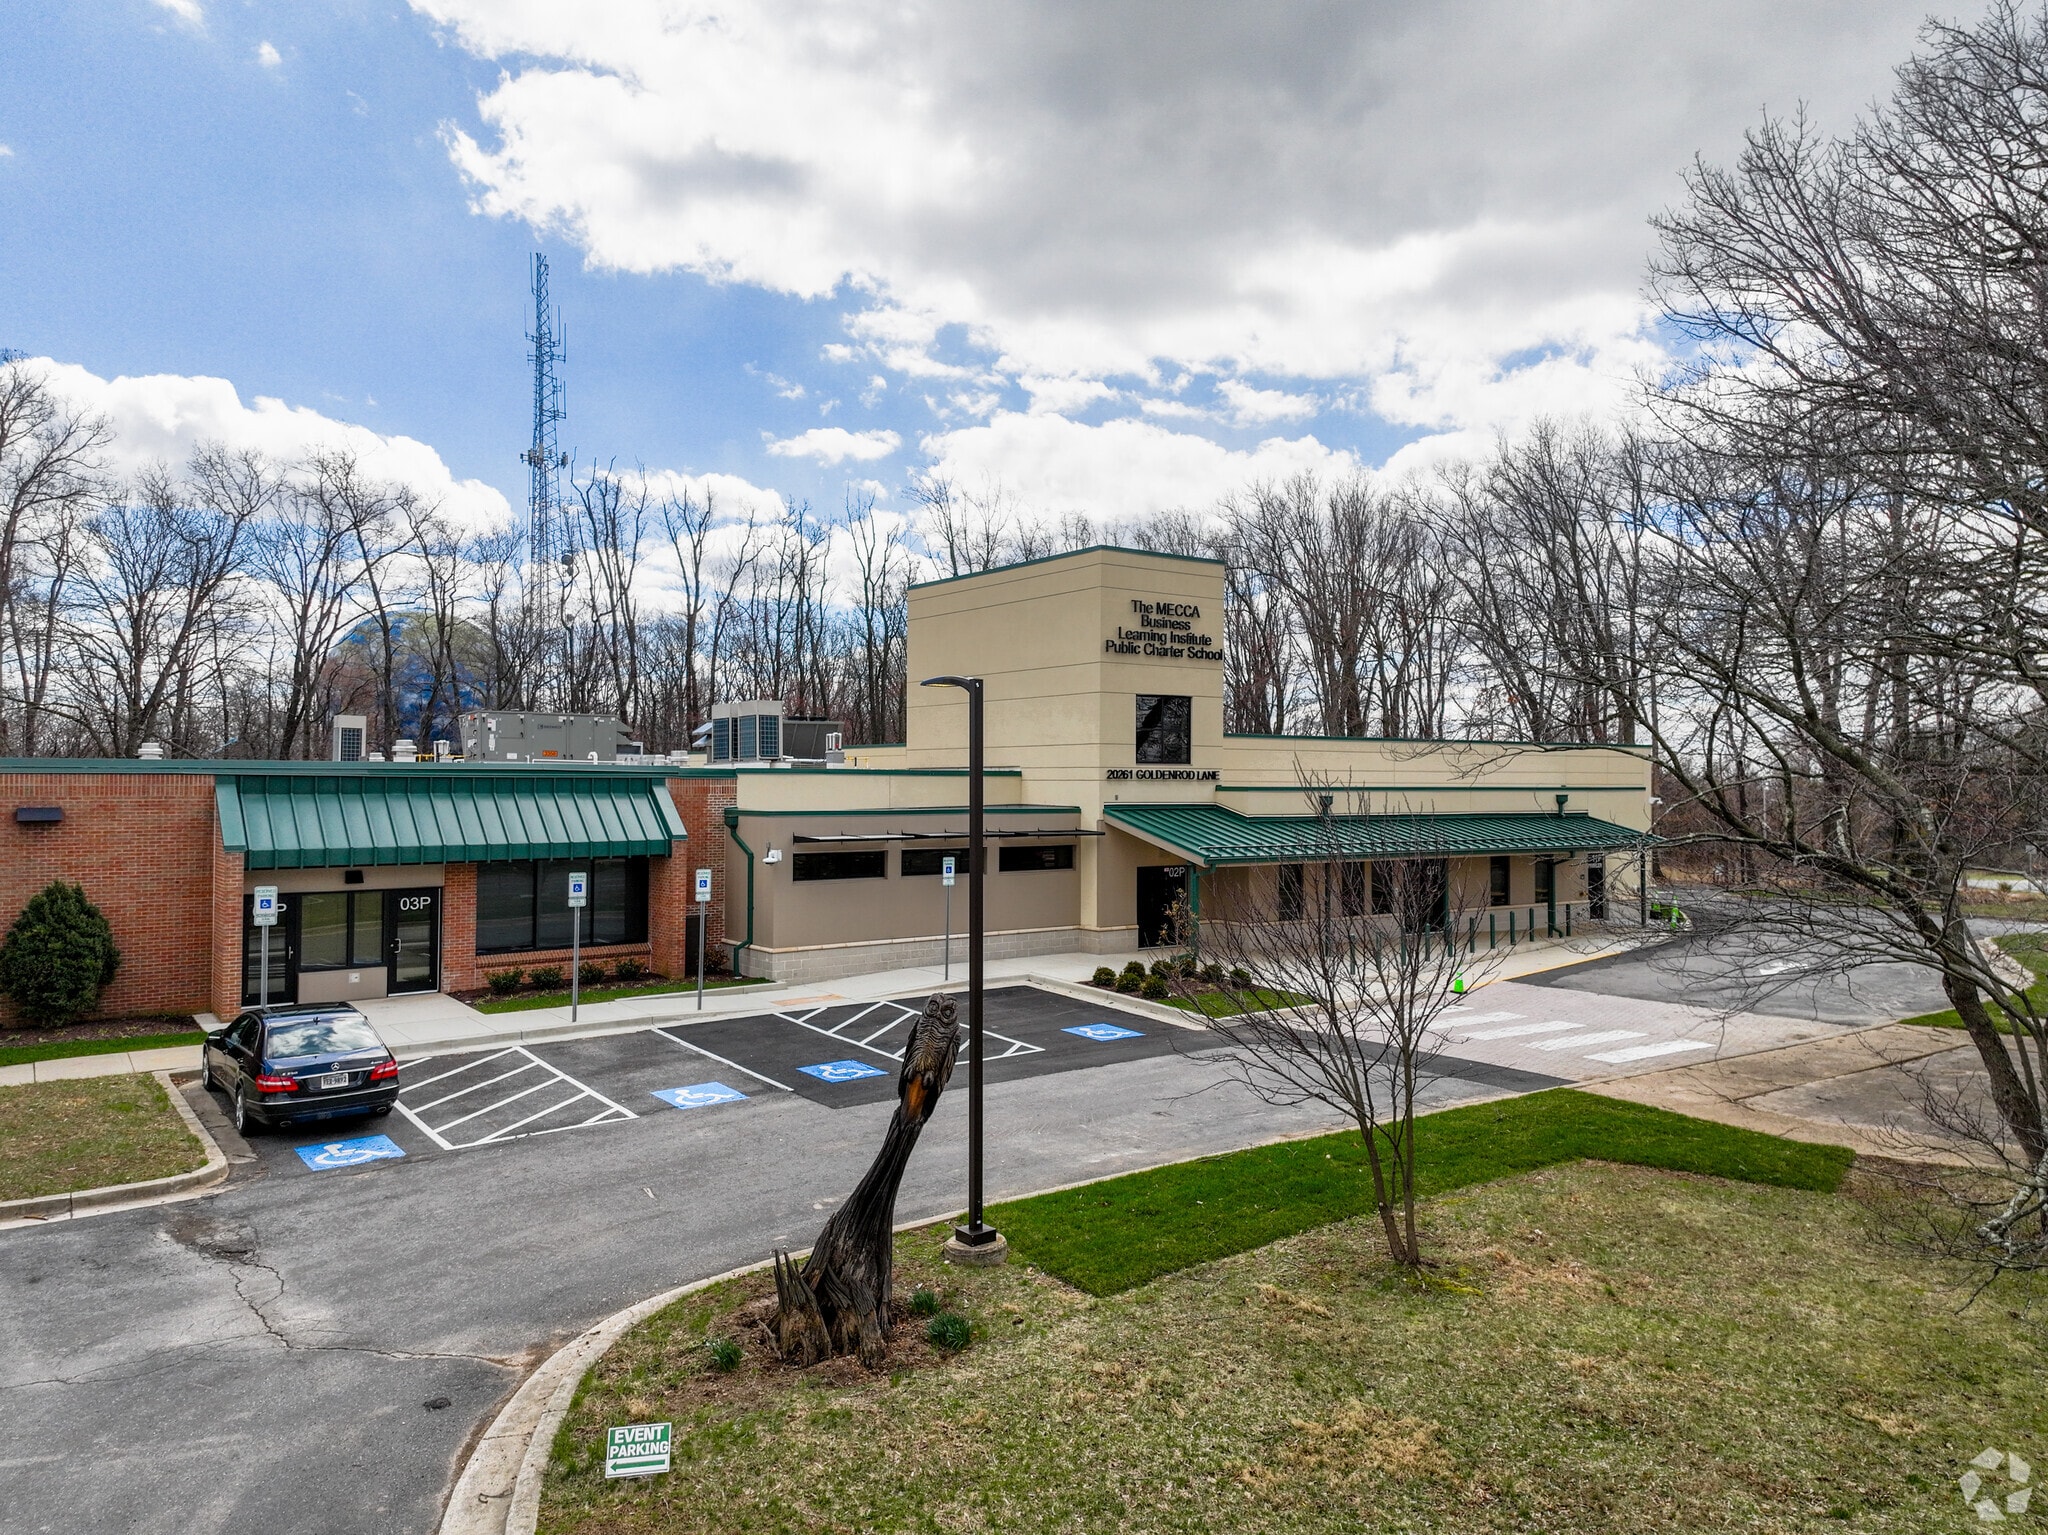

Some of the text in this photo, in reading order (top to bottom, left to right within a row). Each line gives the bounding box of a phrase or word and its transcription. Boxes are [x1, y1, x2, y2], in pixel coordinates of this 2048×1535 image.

[1131, 600, 1200, 618] The MECCA
[1141, 615, 1191, 631] Business
[1118, 627, 1212, 646] Learning Institute
[1105, 640, 1223, 660] Public Charter School
[1106, 769, 1220, 781] 20261 GOLDENROD LANE
[1168, 866, 1185, 877] 02P
[400, 896, 431, 910] 03P
[614, 1426, 664, 1444] EVENT
[609, 1441, 669, 1459] PARKING
